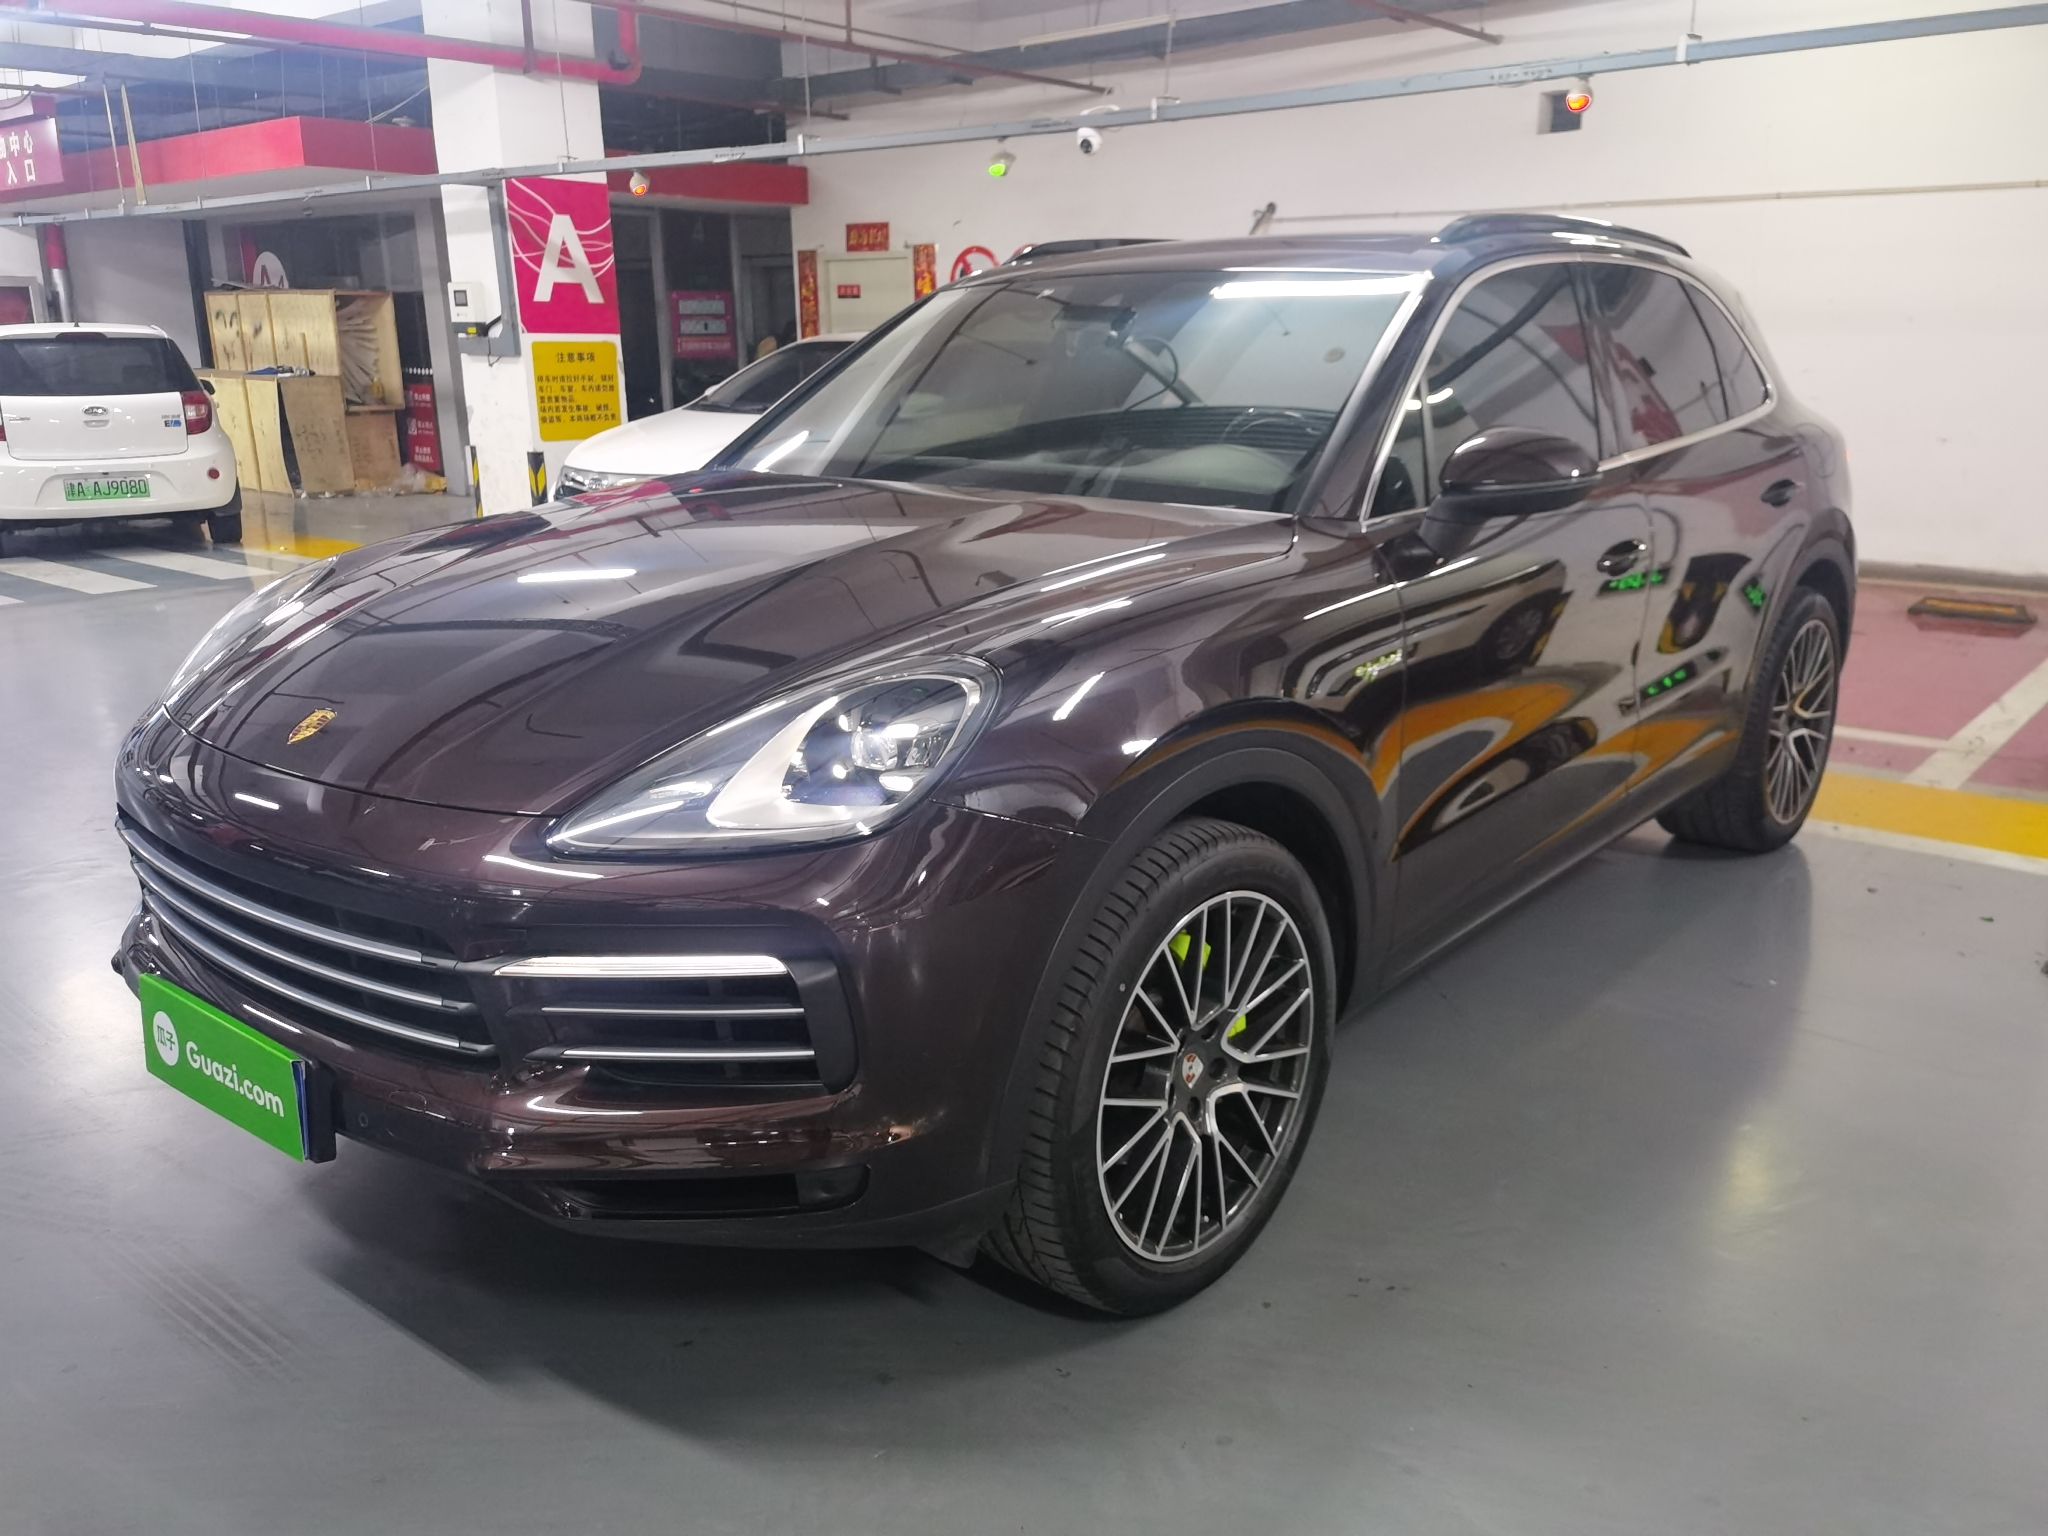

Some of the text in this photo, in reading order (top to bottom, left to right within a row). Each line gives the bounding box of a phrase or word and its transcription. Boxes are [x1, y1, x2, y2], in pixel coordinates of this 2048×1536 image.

[7, 159, 36, 185] 入口
[533, 214, 605, 304] A
[557, 352, 596, 363] 注意事项
[93, 479, 148, 496] AJ9080
[156, 1024, 176, 1052] 瓜子
[186, 1041, 285, 1118] Guazi.com
